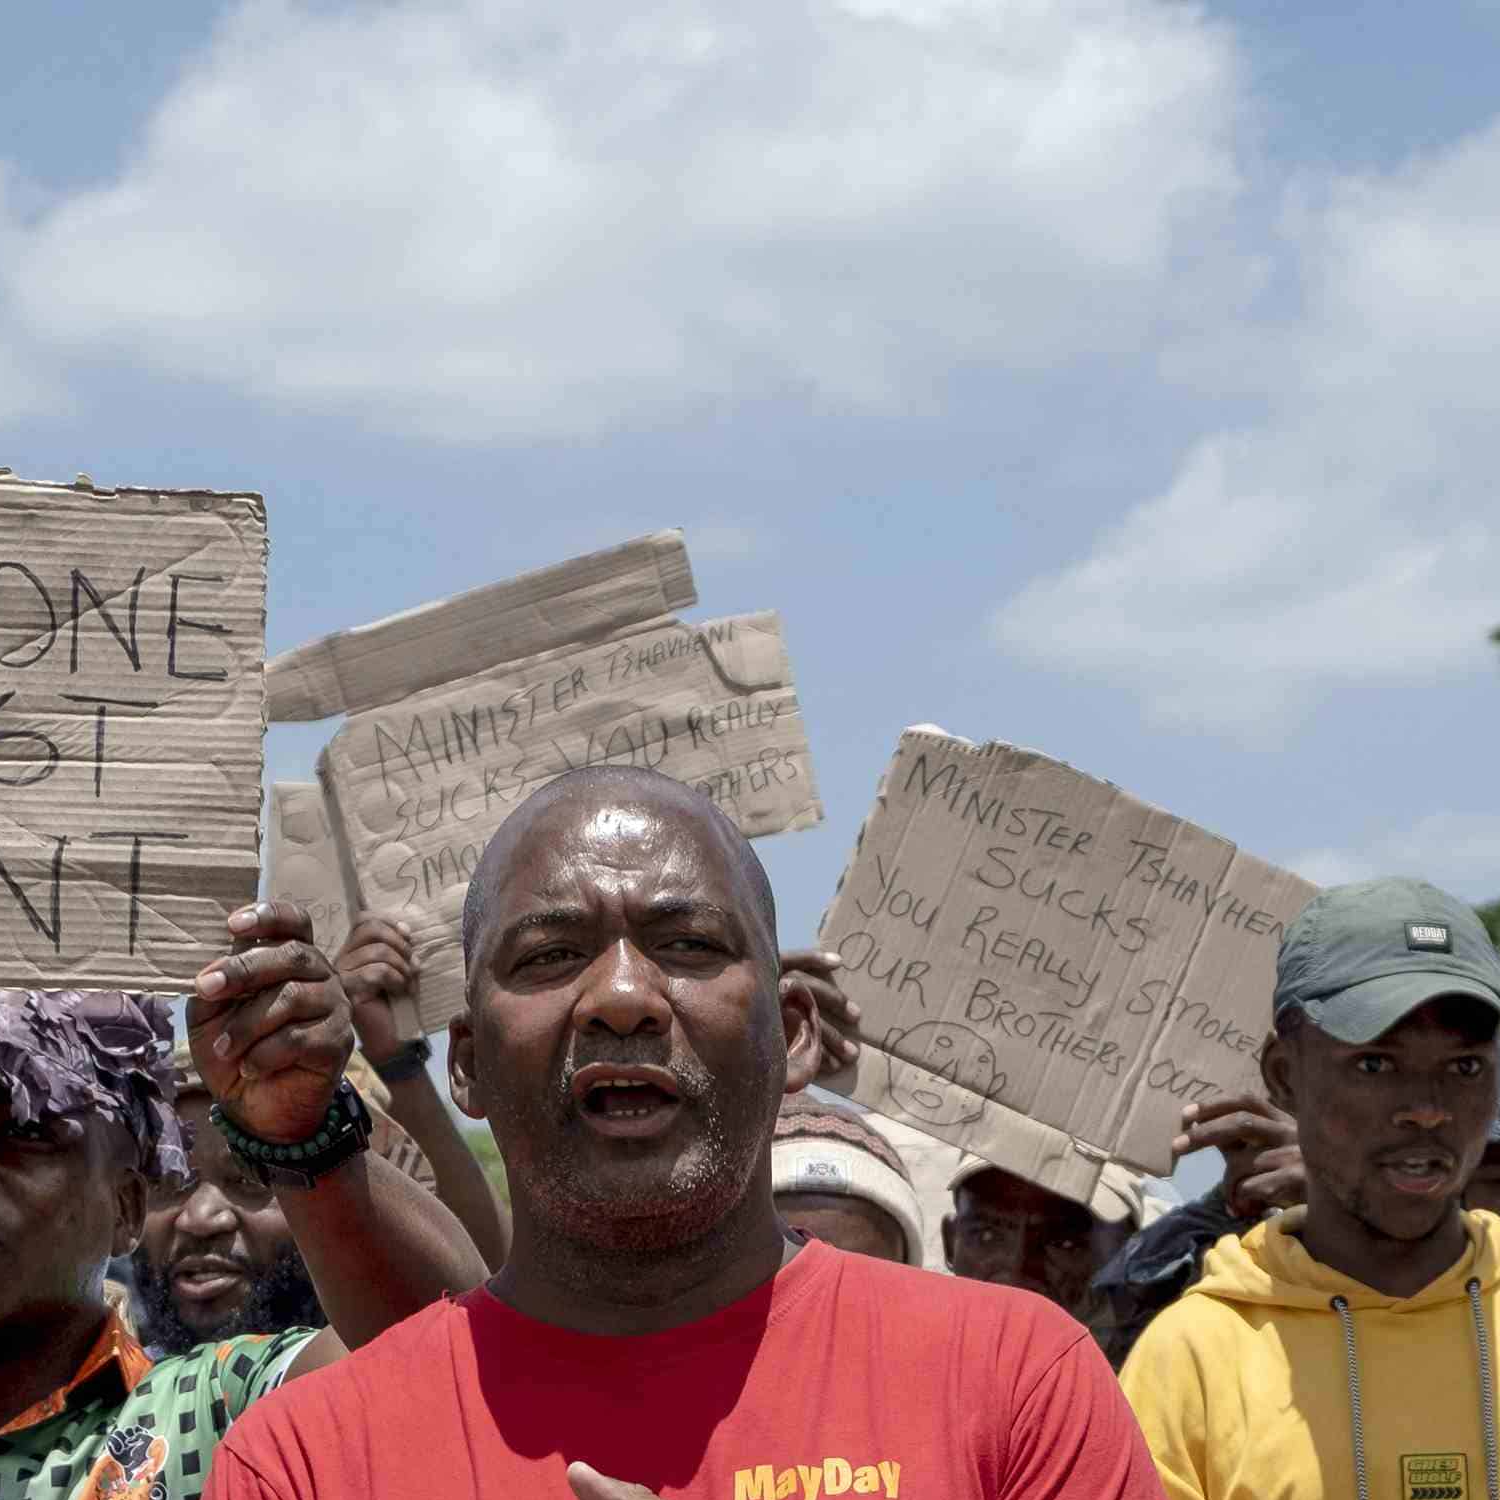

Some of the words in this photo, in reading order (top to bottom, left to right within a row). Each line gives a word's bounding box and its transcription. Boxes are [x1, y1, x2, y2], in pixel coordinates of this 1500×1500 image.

[372, 669, 589, 798] MINISTER
[394, 766, 528, 842] SUCKS
[686, 699, 785, 751] REALLY
[904, 755, 1093, 857] MINISTER
[1124, 838, 1286, 946] TSHAVHEN
[974, 847, 1154, 954] SUCKS
[855, 854, 939, 932] YOU
[965, 905, 1102, 1009] REALLY
[835, 931, 932, 1008] OUR
[964, 979, 1127, 1077] BROTHERS
